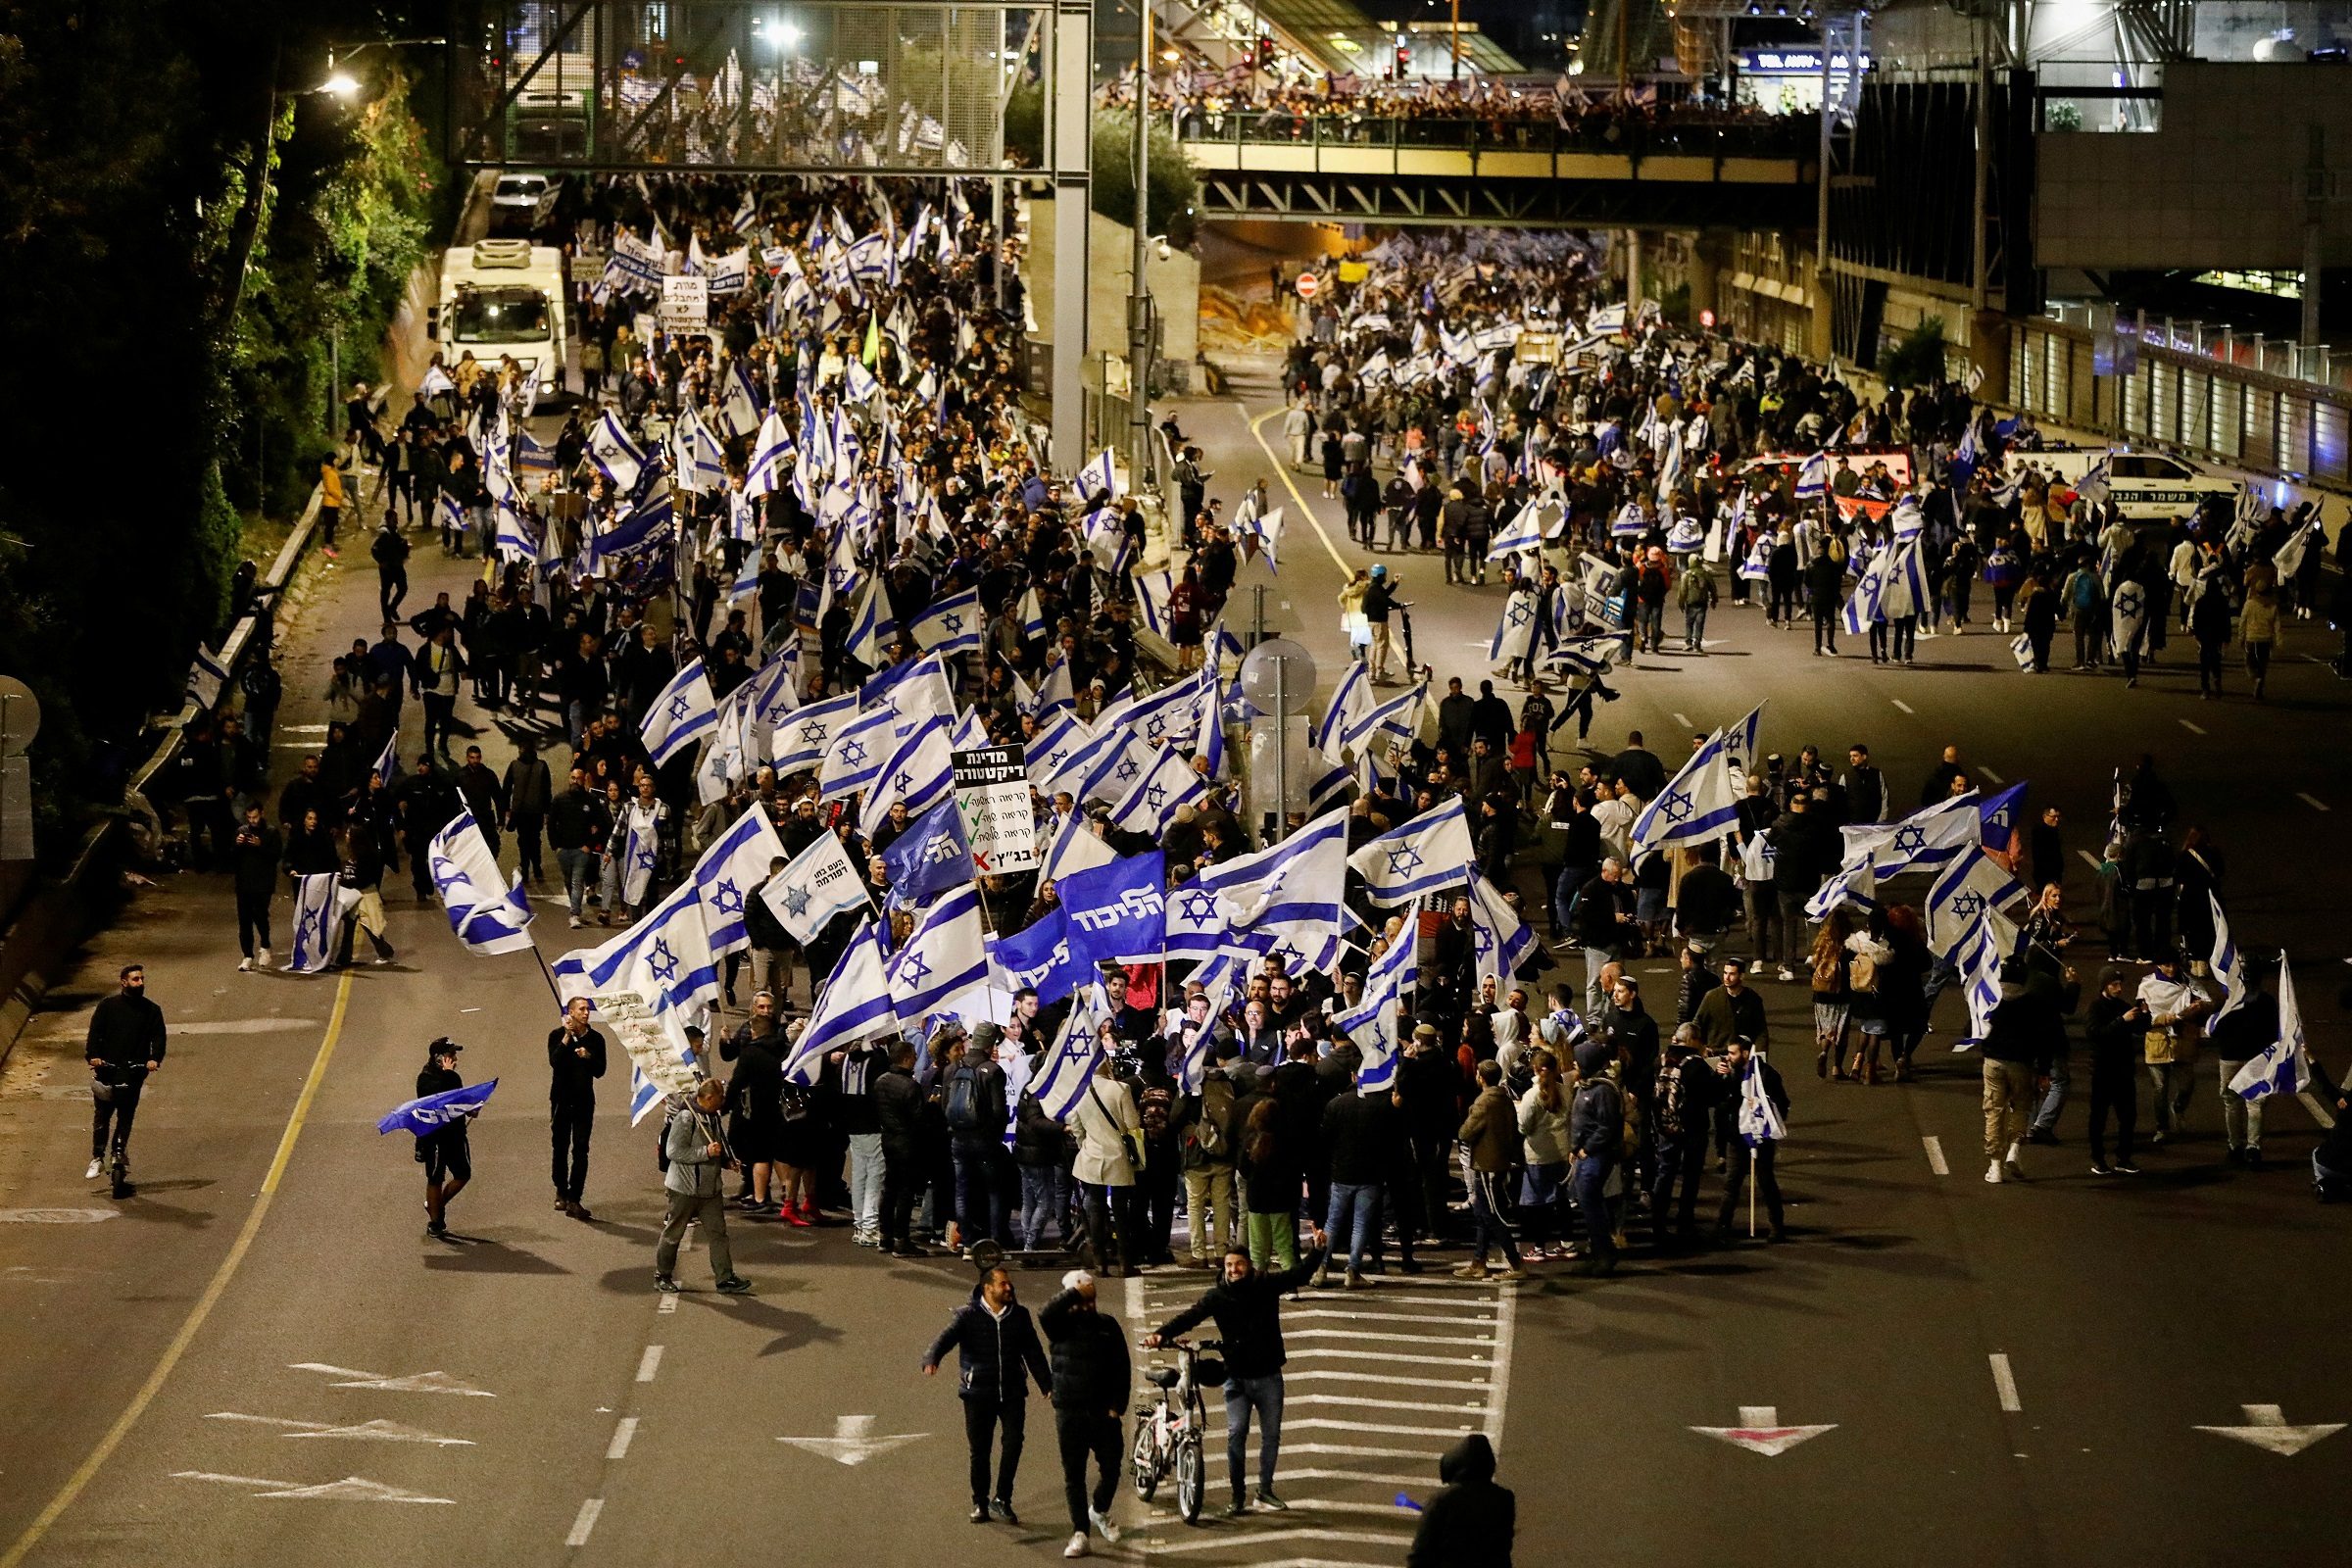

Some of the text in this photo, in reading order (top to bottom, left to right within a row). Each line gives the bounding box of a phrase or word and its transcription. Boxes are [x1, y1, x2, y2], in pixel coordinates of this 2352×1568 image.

[673, 281, 698, 290] מוות
[675, 304, 689, 314] לא
[2110, 492, 2187, 501] משמר הגבו
[1528, 702, 1544, 714] FOX
[966, 751, 1008, 764] מדינת
[955, 764, 1025, 781] דיקטטורה
[999, 792, 1026, 803] קריאה
[1002, 809, 1029, 820] קריאה
[1004, 827, 1031, 839] קריאה
[827, 858, 845, 871] העם
[815, 865, 849, 888] רפורמה
[1071, 882, 1164, 932] הליכוד
[1013, 937, 1071, 989] ליכו
